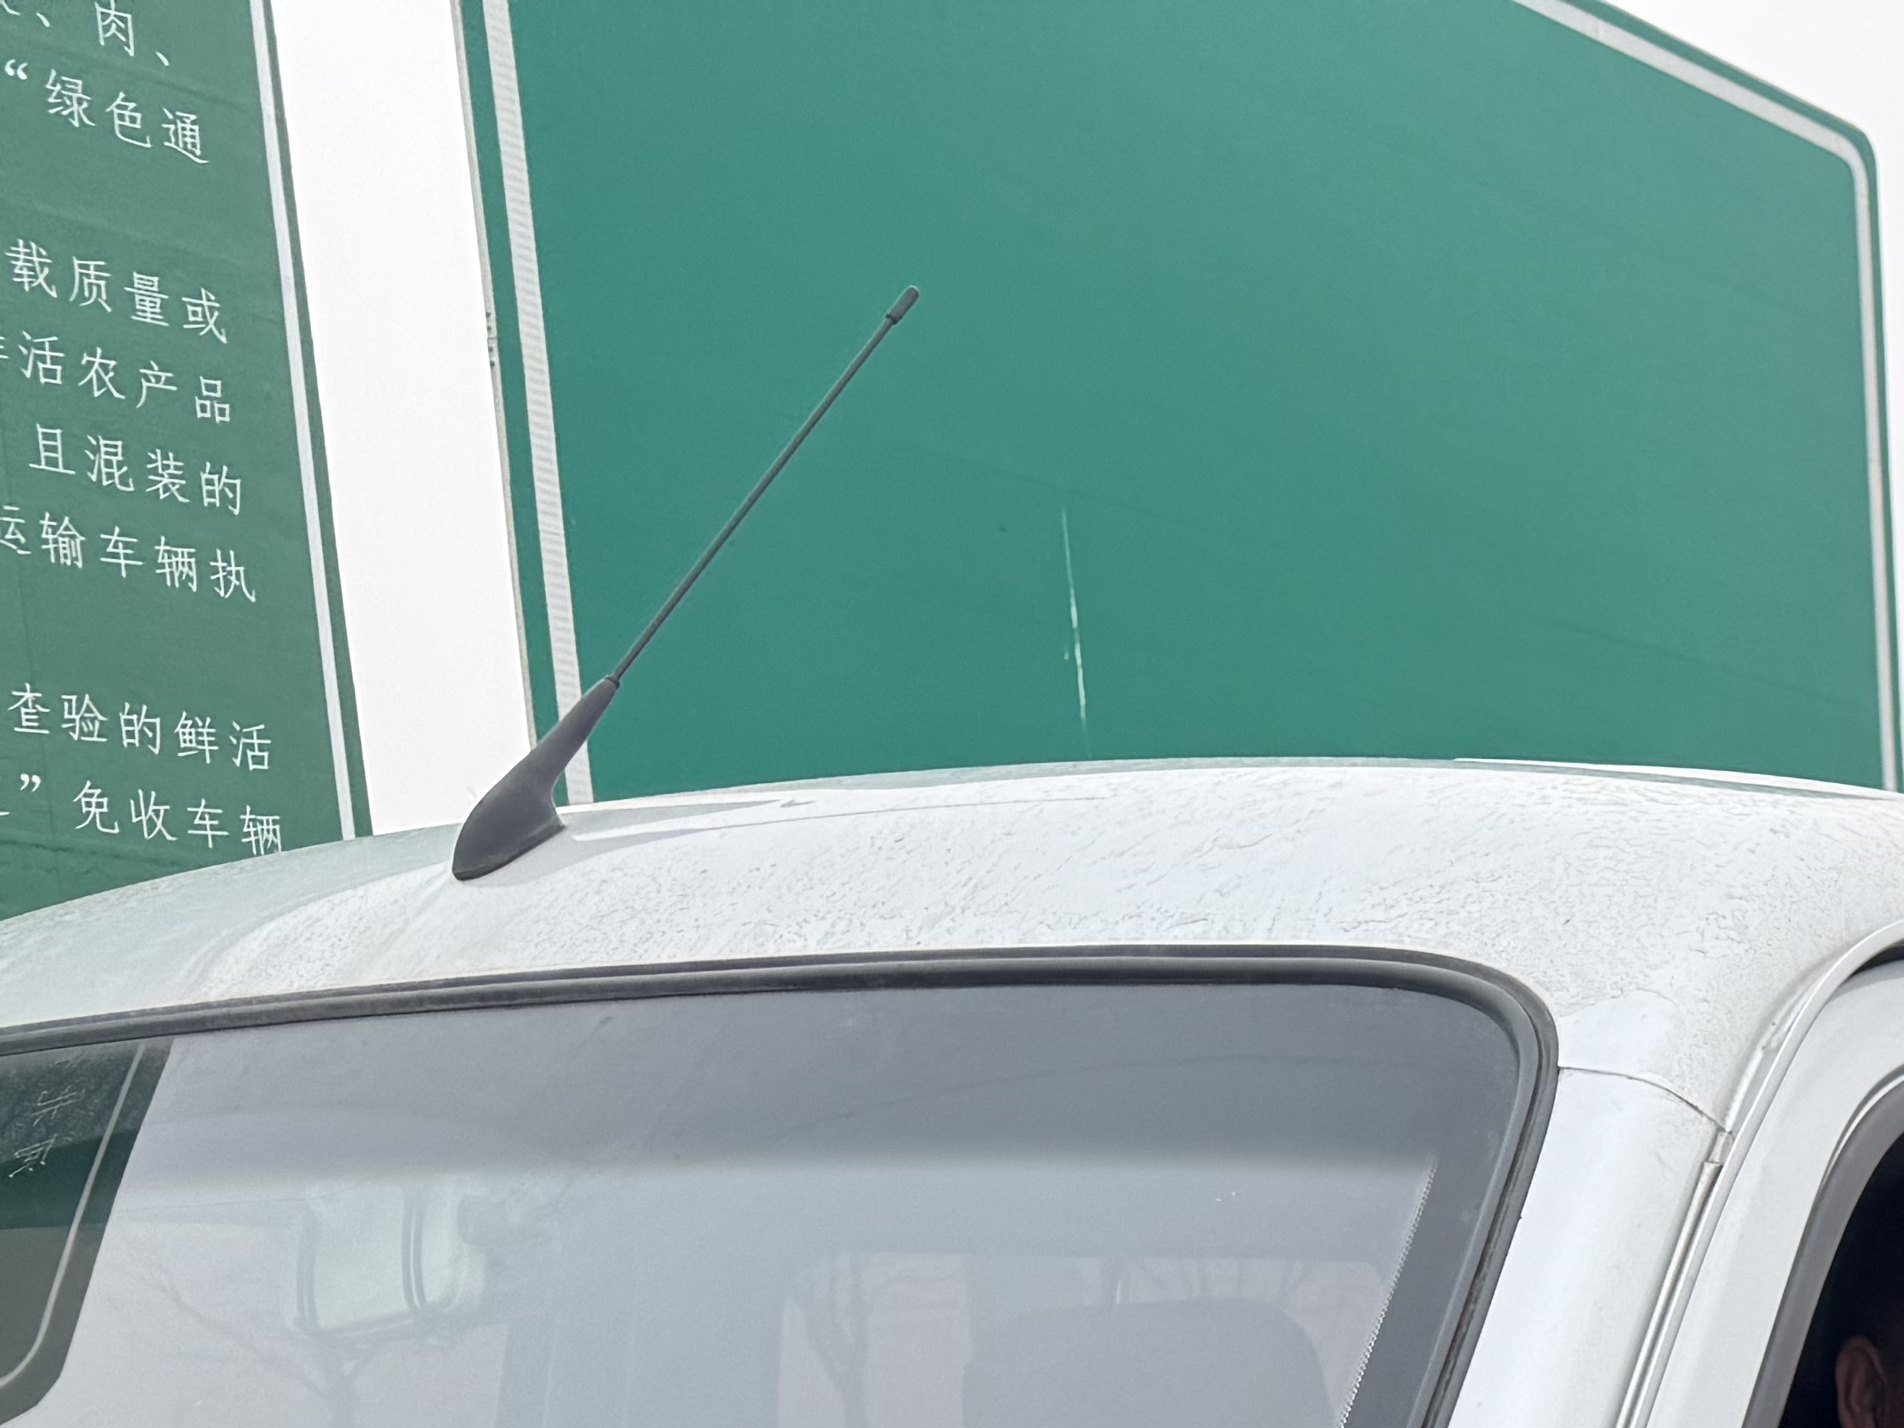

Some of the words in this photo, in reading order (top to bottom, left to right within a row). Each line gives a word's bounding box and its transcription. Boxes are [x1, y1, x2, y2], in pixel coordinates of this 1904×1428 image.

[6, 238, 228, 344] 载质量或
[0, 330, 231, 425] 活农产品
[29, 423, 242, 516] 且混装的
[8, 682, 272, 771] 查验的鲜活
